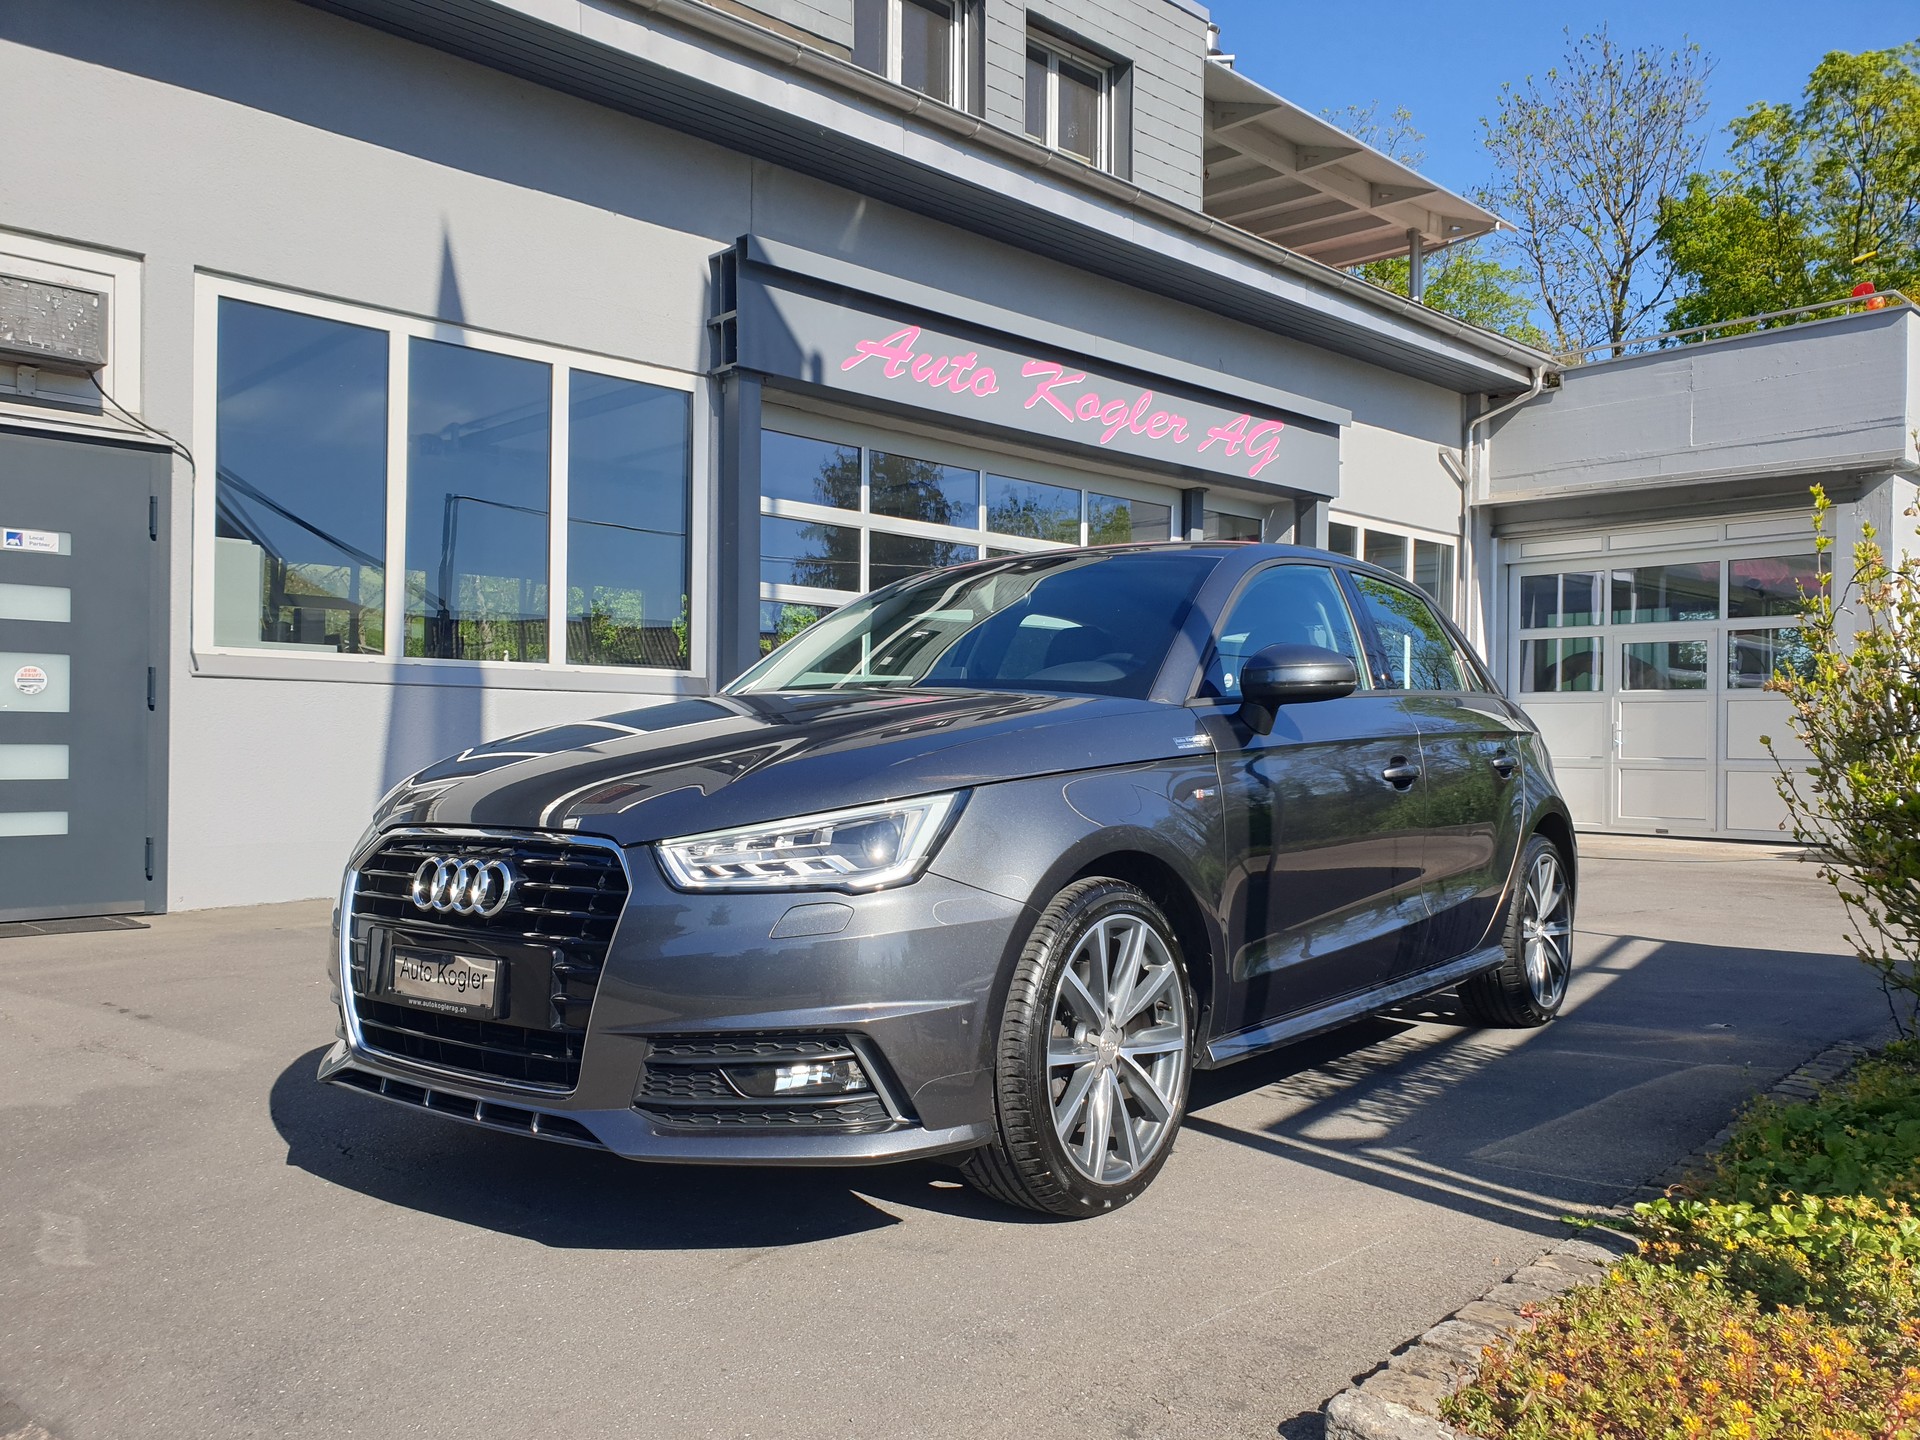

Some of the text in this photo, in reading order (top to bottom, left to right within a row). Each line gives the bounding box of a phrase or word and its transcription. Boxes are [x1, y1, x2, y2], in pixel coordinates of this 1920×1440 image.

[839, 326, 1286, 478] Auto Kogler AG
[400, 957, 488, 993] Auto Kogler
[408, 998, 467, 1014] www.autokoglerag.ch
